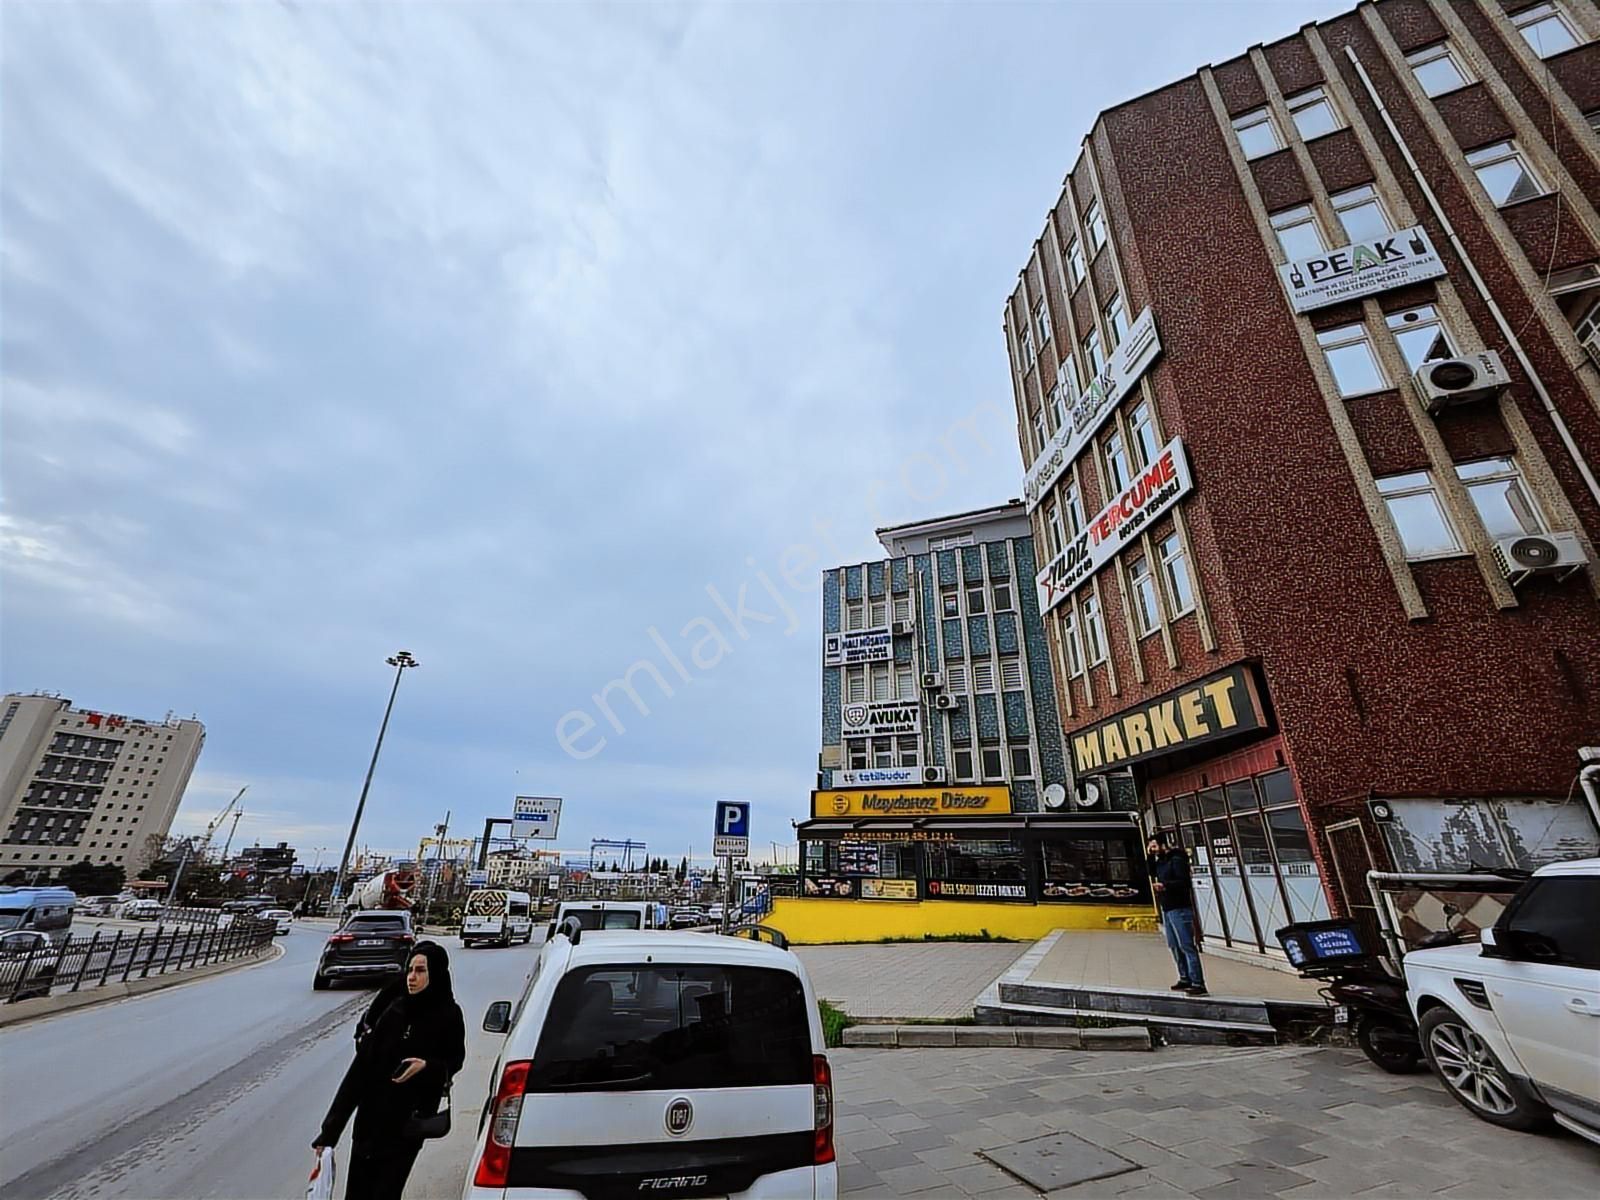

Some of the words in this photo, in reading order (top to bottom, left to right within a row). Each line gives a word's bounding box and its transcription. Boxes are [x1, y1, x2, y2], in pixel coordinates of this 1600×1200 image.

[1307, 238, 1403, 280] PEAK
[1049, 531, 1089, 586] YILDIZ
[869, 708, 919, 725] AVUKAT
[1074, 675, 1238, 773] MARKET
[724, 806, 742, 833] P
[638, 1175, 708, 1190] FIORINO
